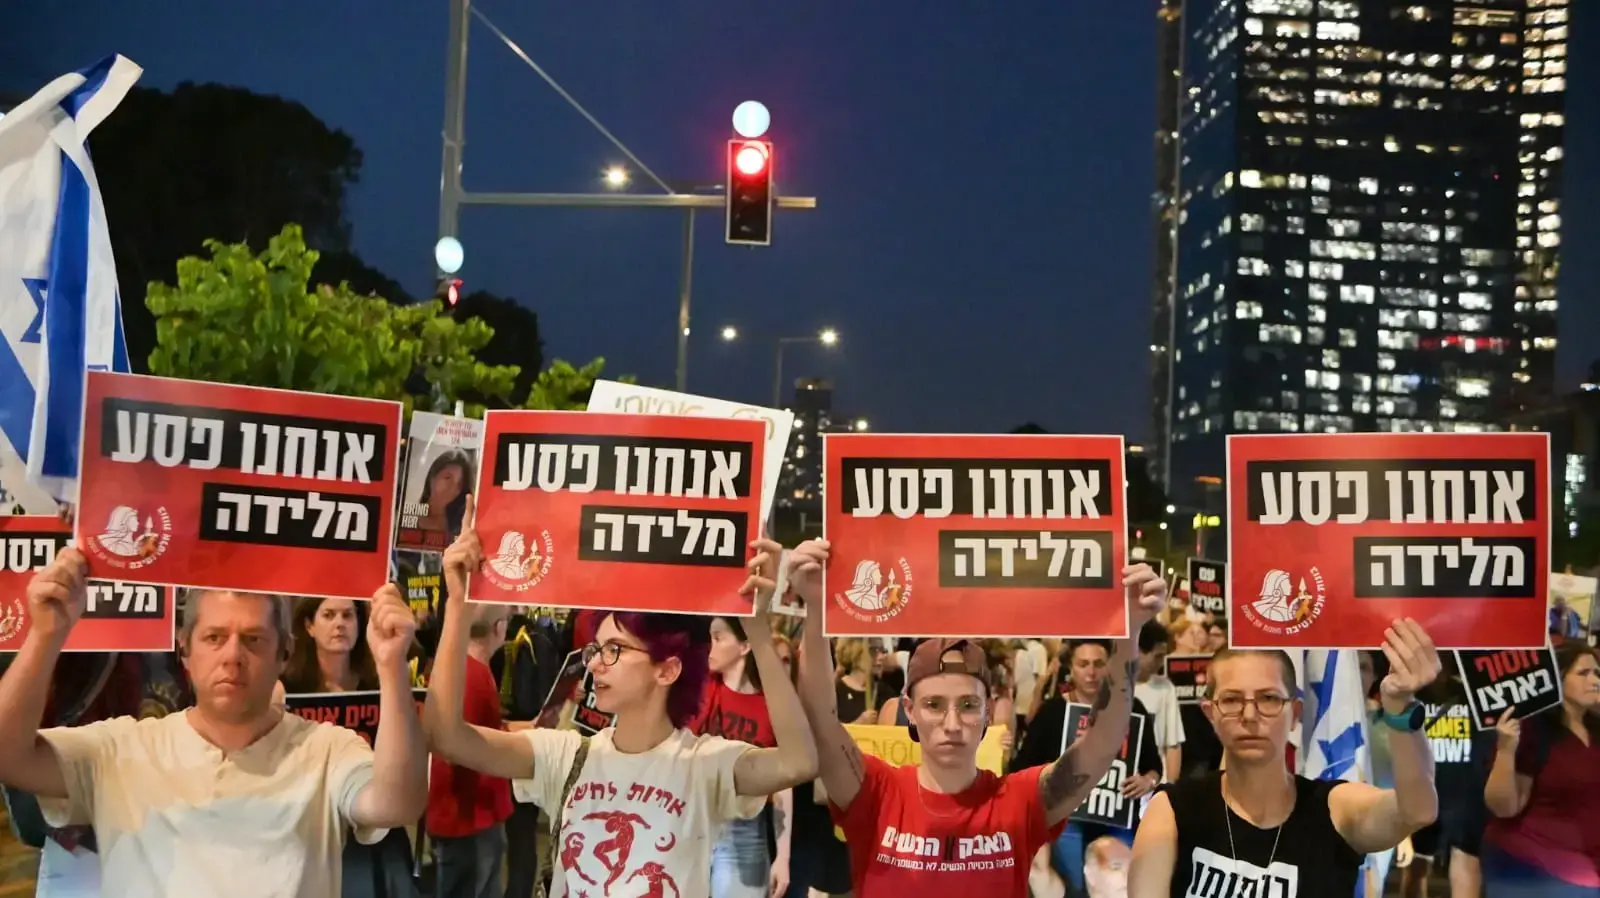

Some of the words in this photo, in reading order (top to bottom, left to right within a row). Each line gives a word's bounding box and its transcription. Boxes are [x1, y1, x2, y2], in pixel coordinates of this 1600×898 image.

[111, 410, 226, 470] פסע
[240, 421, 376, 484] אנחנו
[502, 442, 600, 493] פסע
[613, 444, 742, 500] אנחנו
[215, 491, 370, 542] מלידה
[403, 503, 429, 516] BRING
[852, 467, 954, 519] פסע
[968, 467, 1101, 520] אנחנו
[1259, 470, 1369, 526] פסע
[1384, 470, 1525, 525] אנחנו
[401, 515, 419, 529] HER
[593, 510, 737, 557] מלידה
[954, 531, 1102, 578] מלידה
[1370, 537, 1525, 587] מלידה
[86, 581, 157, 612] מליד
[1476, 668, 1554, 713] בארצו
[1425, 716, 1471, 738] OME!
[1429, 738, 1472, 762] OW!
[881, 825, 940, 856] הנשים
[958, 831, 1012, 859] מאבק
